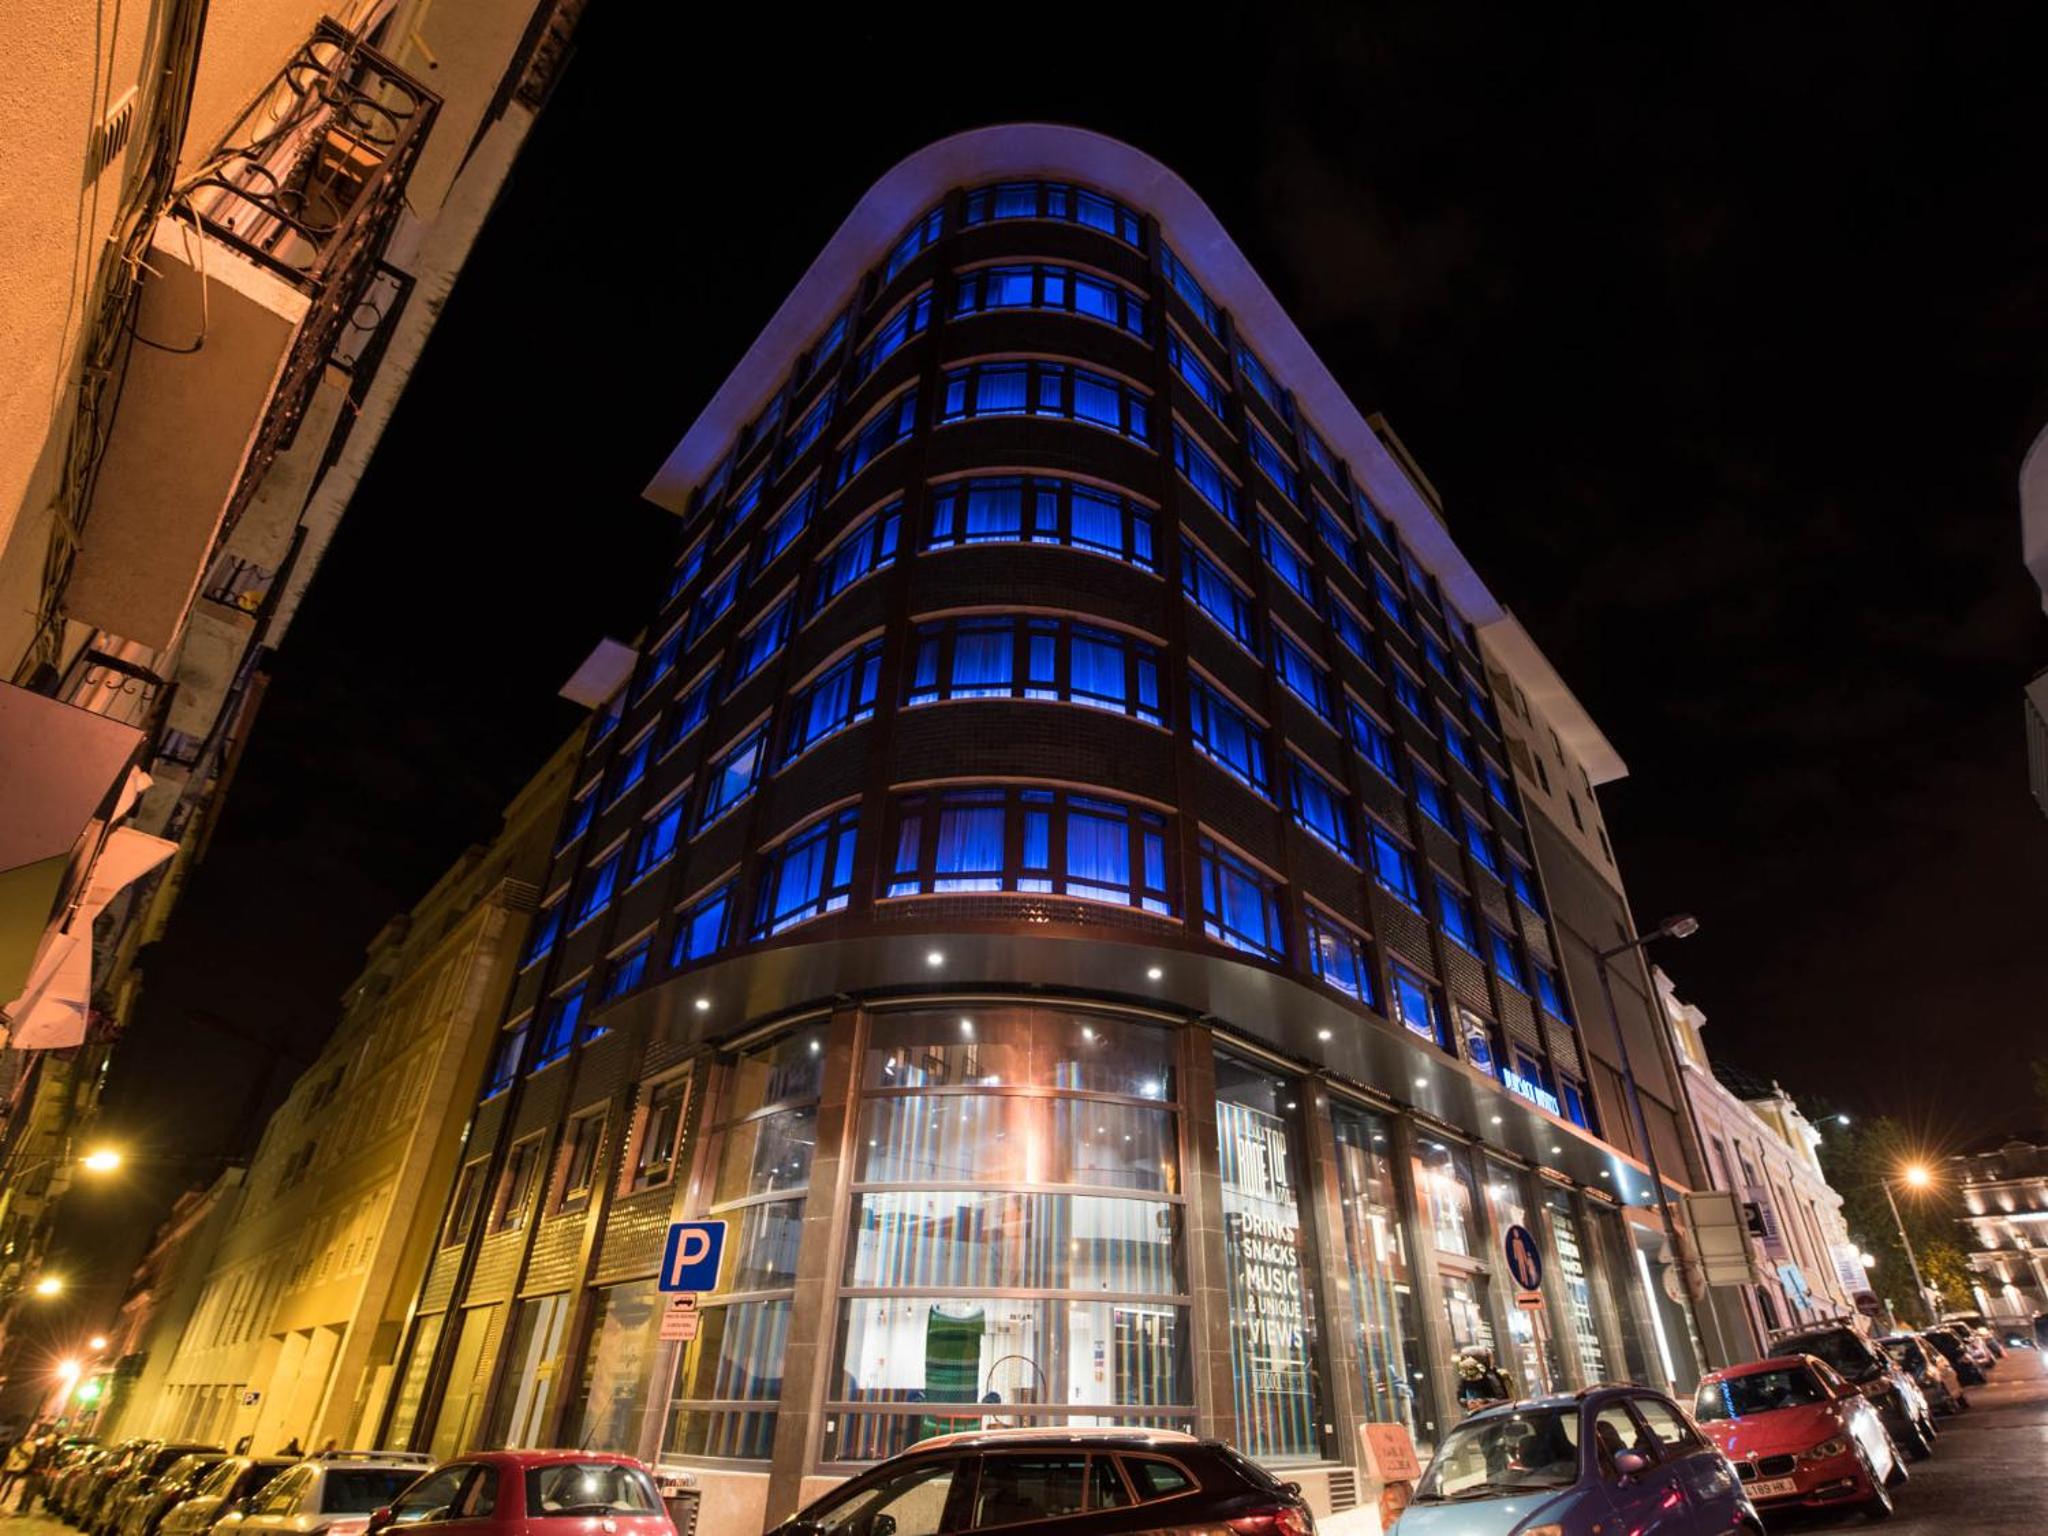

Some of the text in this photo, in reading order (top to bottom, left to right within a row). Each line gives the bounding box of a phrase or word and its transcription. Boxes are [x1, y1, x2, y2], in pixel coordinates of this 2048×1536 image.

[1242, 1212, 1295, 1242] DRINKS
[671, 1229, 710, 1286] P
[1243, 1237, 1297, 1266] SNACKS
[1246, 1263, 1299, 1296] MUSIC
[1258, 1295, 1302, 1319] UNIQUE
[1247, 1317, 1303, 1348] VIEWS
